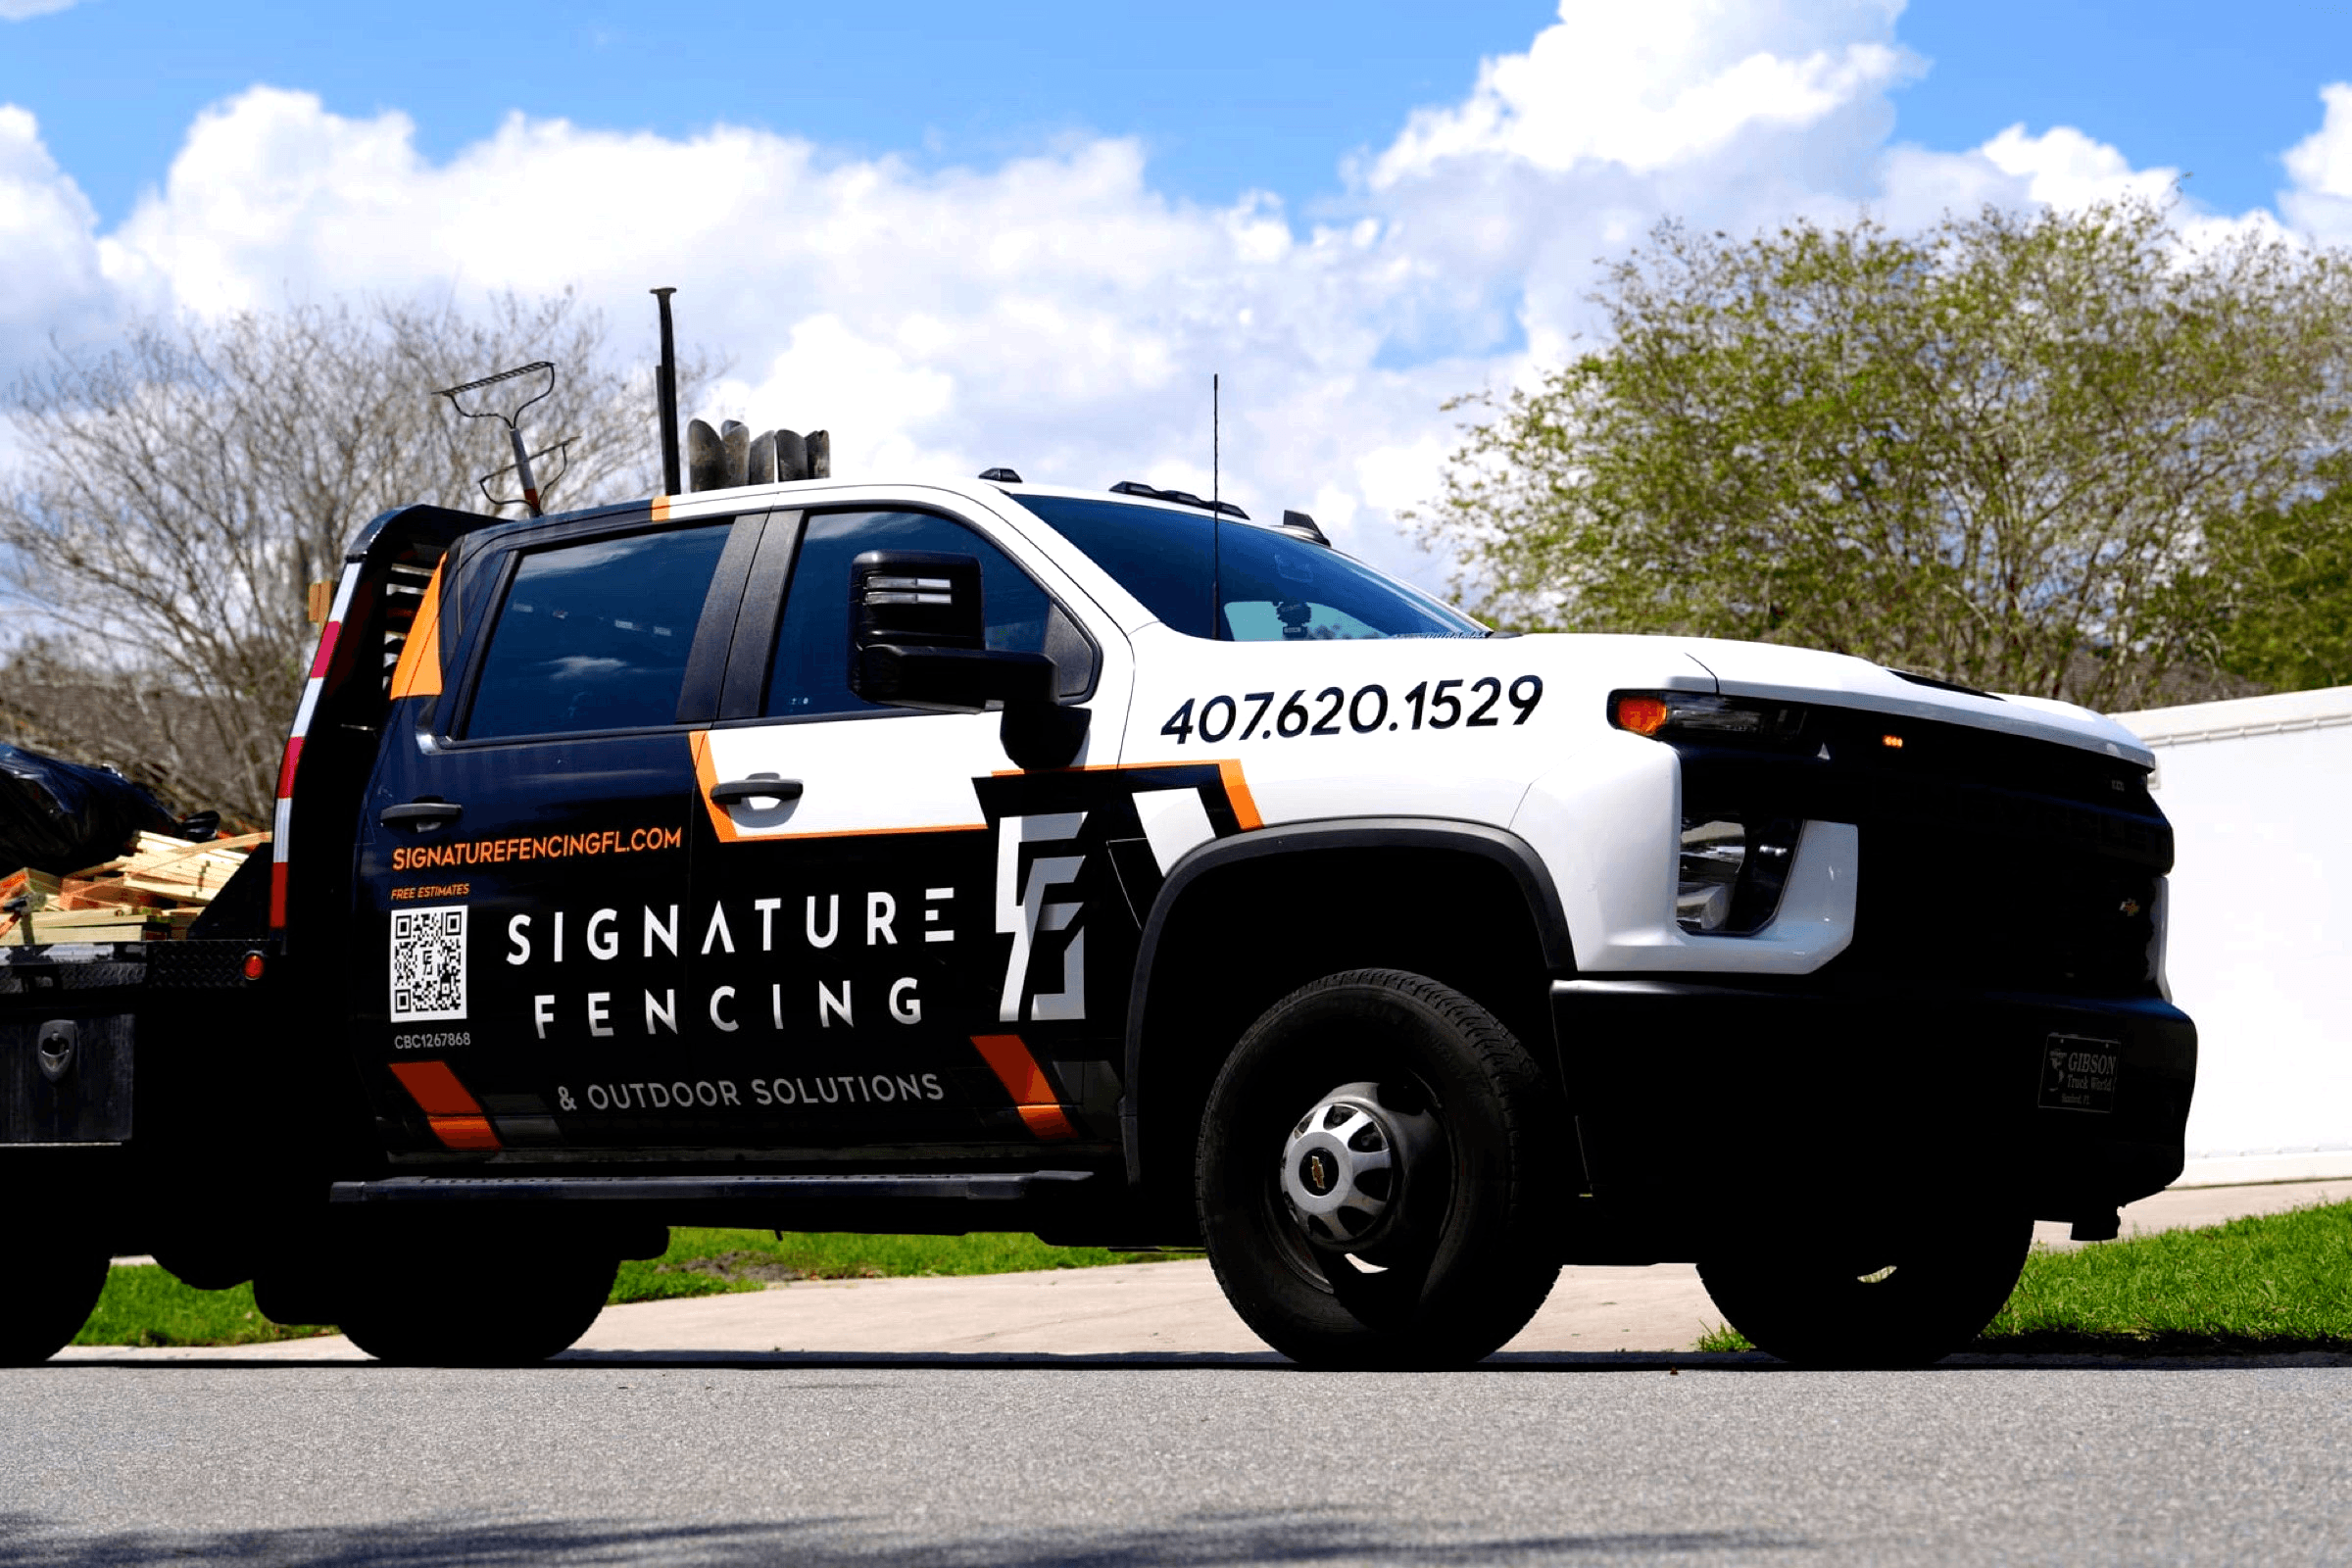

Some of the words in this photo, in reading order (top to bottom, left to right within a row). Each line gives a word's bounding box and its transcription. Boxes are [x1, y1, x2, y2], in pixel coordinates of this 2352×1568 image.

[1159, 674, 1544, 745] 407.620.1529
[392, 827, 682, 870] SIGNATUREFENCINGFL.COM
[391, 887, 416, 901] FREE
[417, 883, 469, 898] ESTIMATES
[506, 887, 955, 965] SIGNATURE
[534, 976, 922, 1039] FENCING
[394, 1032, 471, 1050] CBC1267868
[2067, 1074, 2088, 1090] Truck
[2068, 1052, 2117, 1075] GIBSON
[558, 1086, 577, 1111] &
[587, 1080, 741, 1109] OUTDOOR
[751, 1073, 944, 1105] SOLUTIONS
